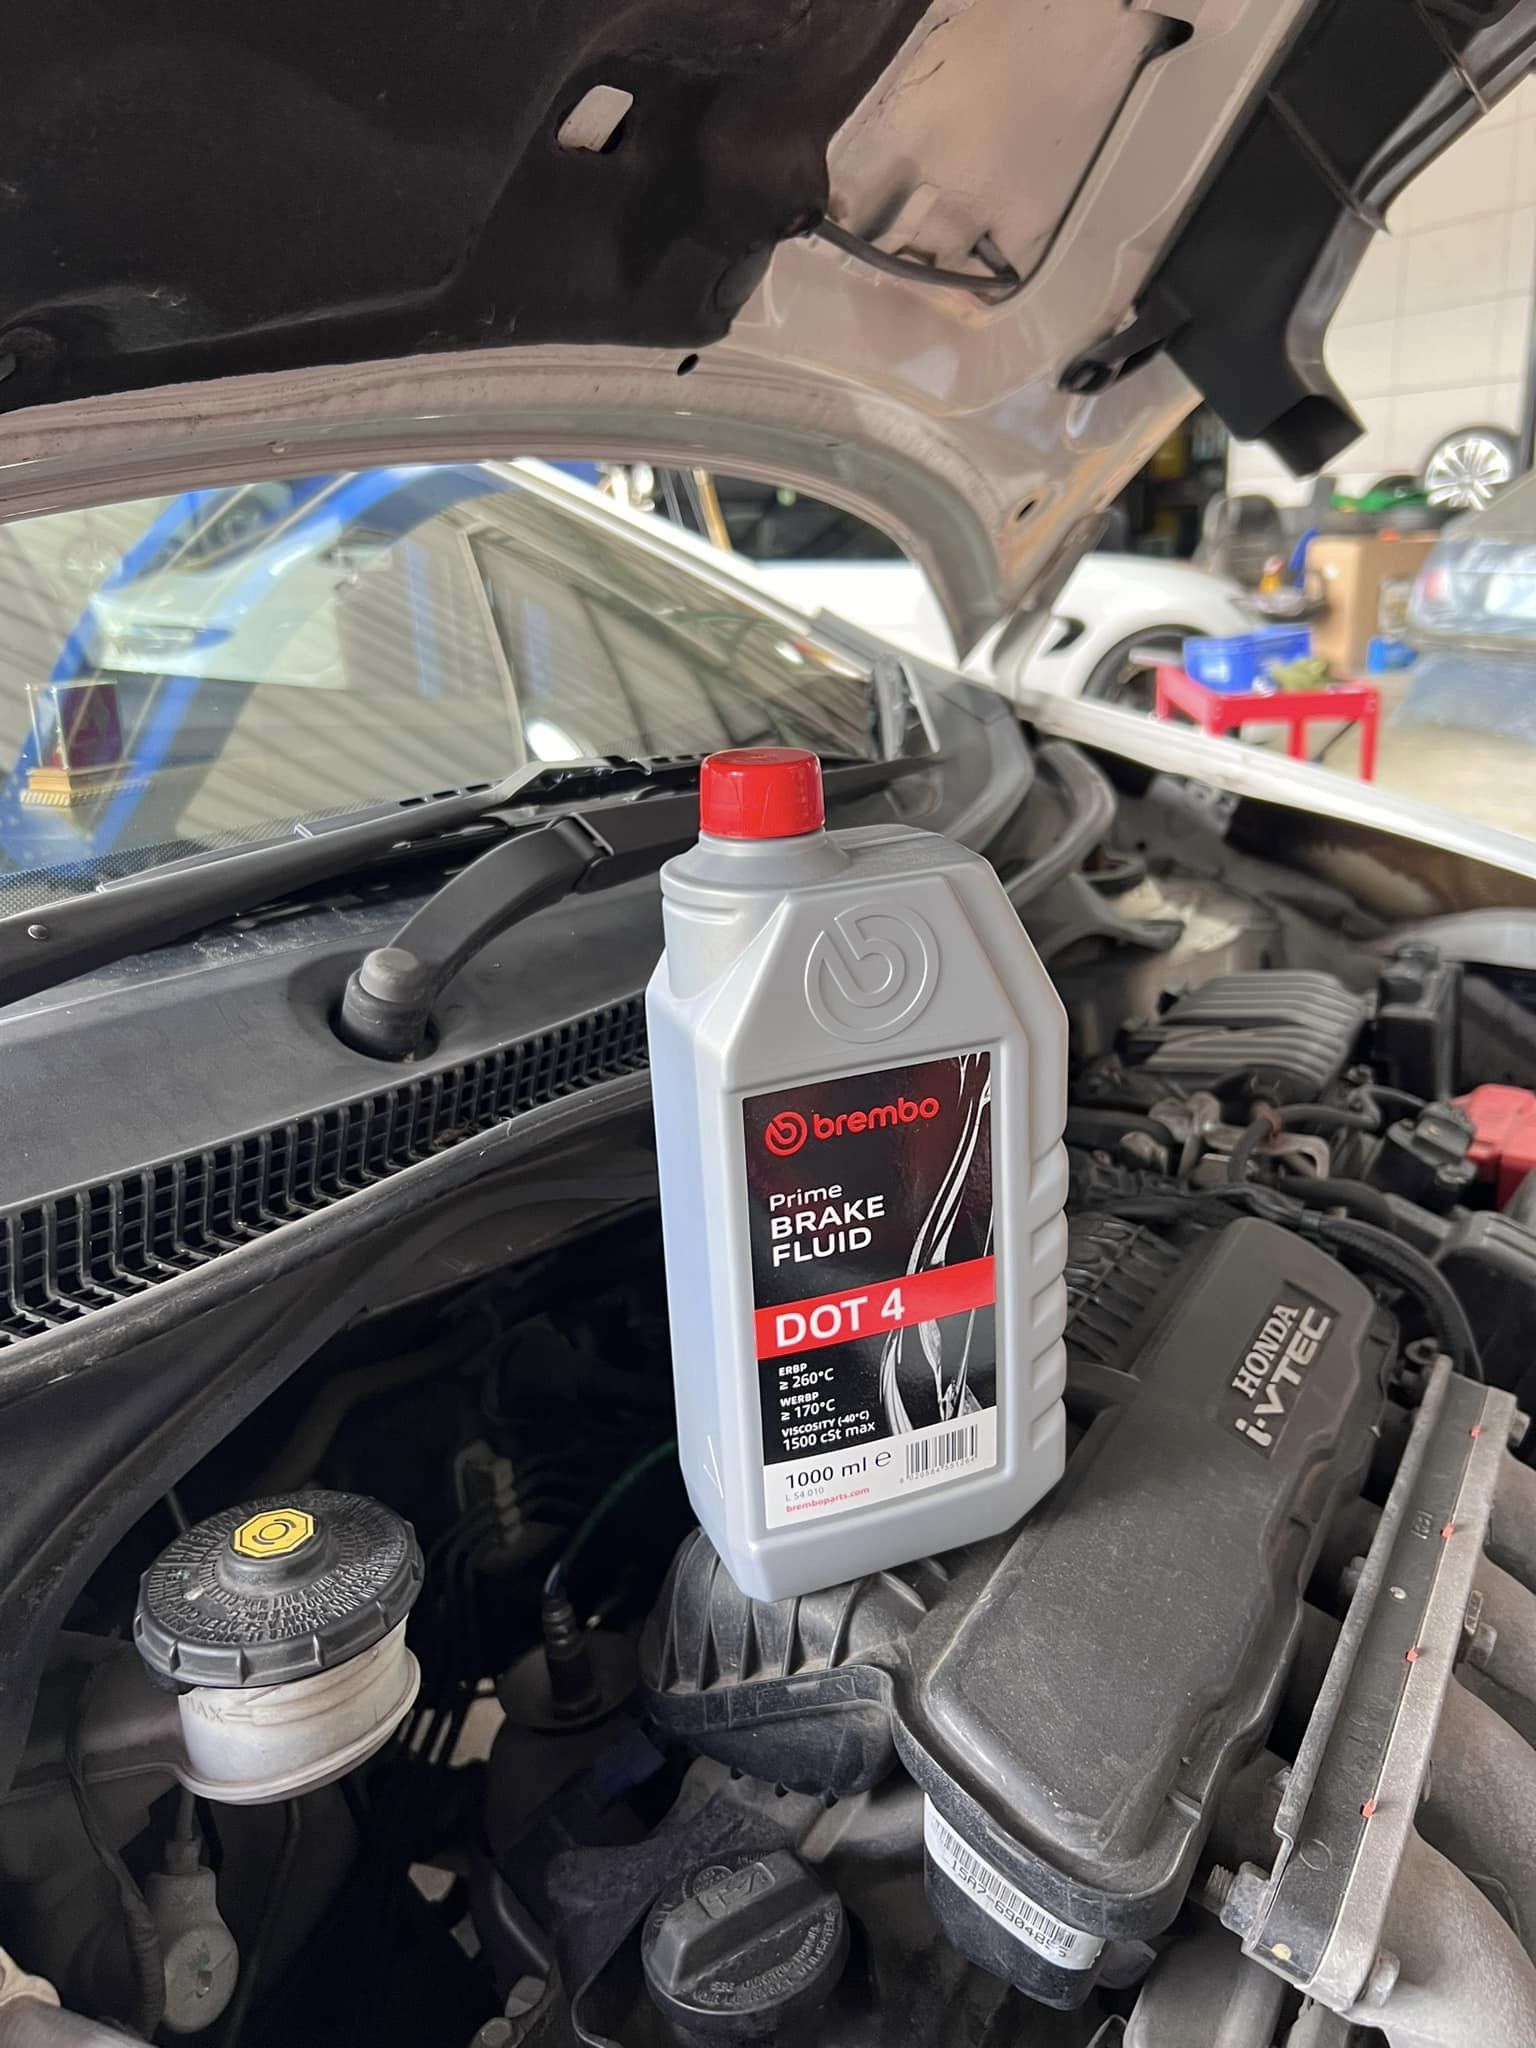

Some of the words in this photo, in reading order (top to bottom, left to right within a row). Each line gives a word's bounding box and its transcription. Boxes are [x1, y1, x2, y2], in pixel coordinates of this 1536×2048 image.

[813, 1097, 940, 1140] brembo
[769, 1184, 843, 1211] Prime
[770, 1195, 886, 1240] BRAKE
[772, 1226, 872, 1268] FLUID
[775, 1296, 869, 1348] DOT
[880, 1287, 905, 1321] 4
[1231, 1304, 1300, 1399] HONDA
[778, 1362, 808, 1377] ERBP
[780, 1391, 819, 1408] WERBP
[781, 1418, 836, 1438] VISCOSITY
[782, 1433, 817, 1451] 1500
[820, 1427, 842, 1444] cSt
[845, 1421, 876, 1437] max
[785, 1466, 835, 1489] 1000
[841, 1456, 867, 1477] ml
[786, 1487, 870, 1513] bremboparts.com
